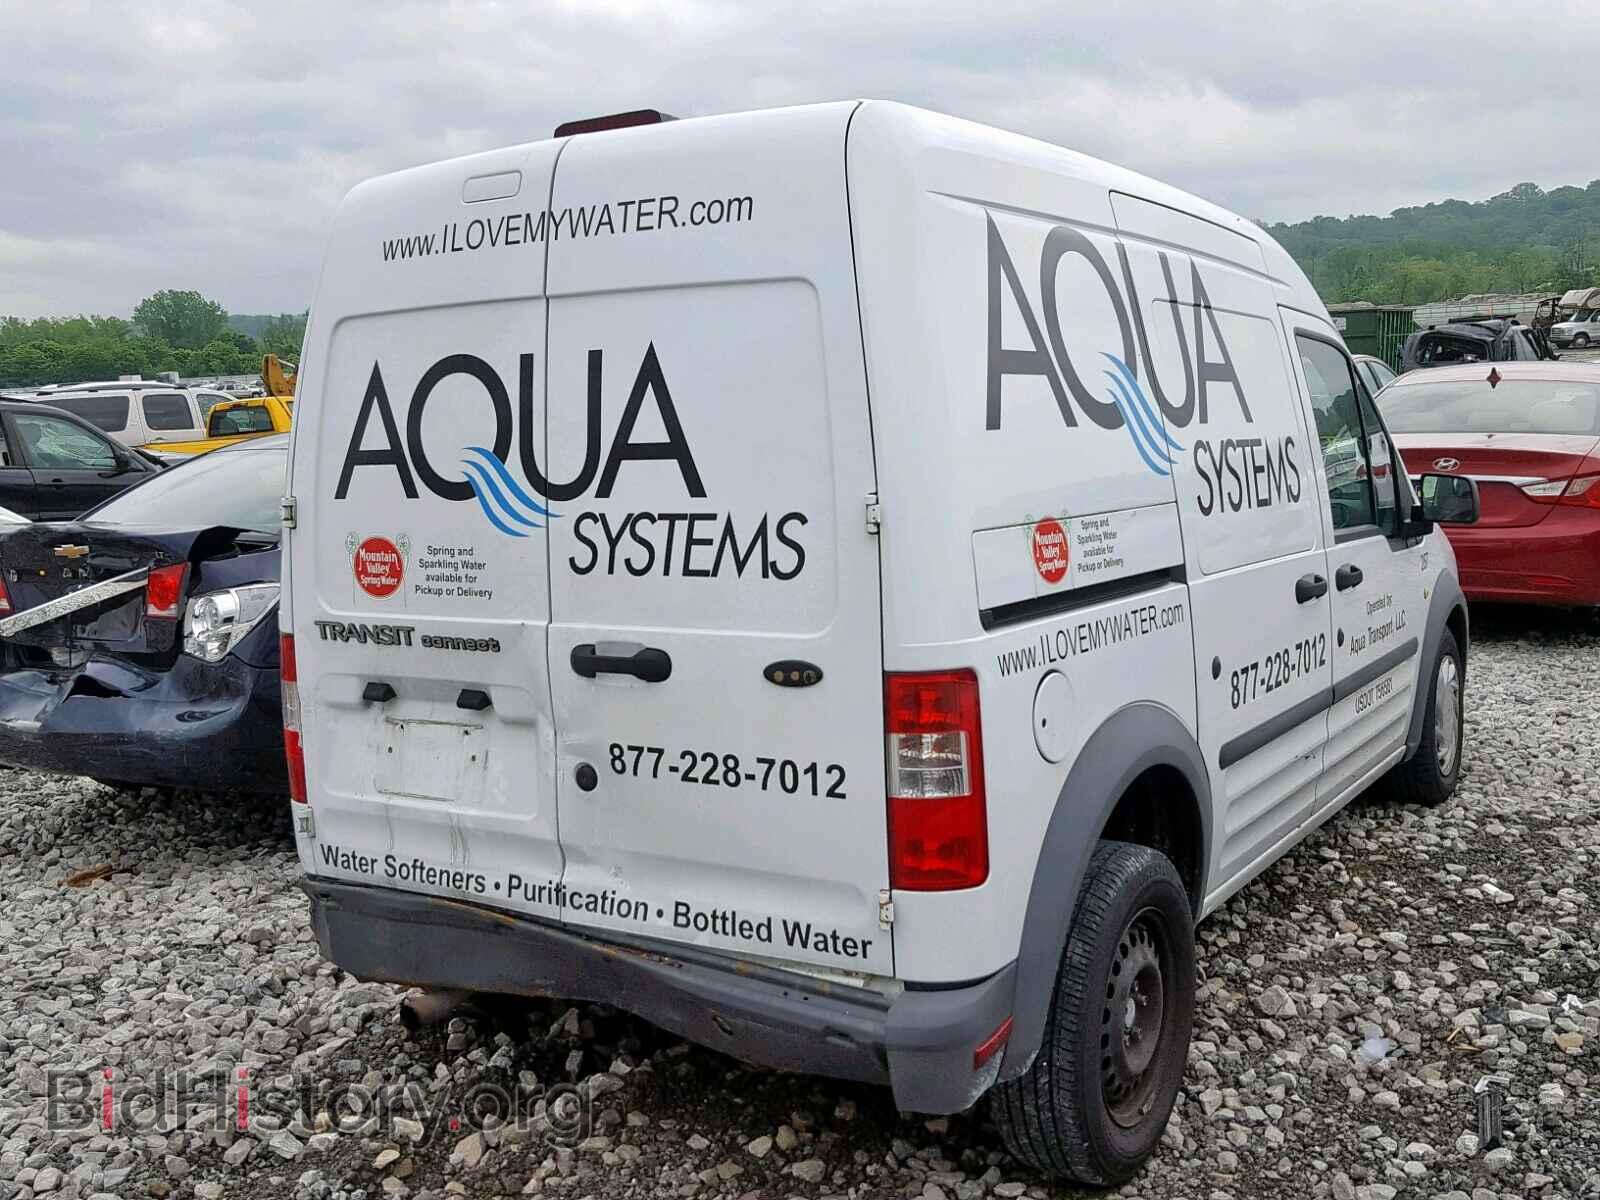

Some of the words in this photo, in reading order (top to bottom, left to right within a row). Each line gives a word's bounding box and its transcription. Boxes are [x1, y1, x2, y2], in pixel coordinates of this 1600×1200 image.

[382, 196, 754, 261] www.ILOVEMYWATER.com
[984, 207, 1254, 430] AQUA
[334, 340, 707, 502] AQUA
[1194, 436, 1300, 516] SYSTEMS
[1081, 519, 1099, 530] Spring
[1100, 517, 1109, 528] and
[569, 511, 808, 580] SYSTEMS
[1077, 532, 1103, 545] Sparkling
[1103, 530, 1118, 540] Water
[359, 548, 400, 571] Mountain
[427, 545, 455, 557] Spring
[457, 546, 474, 557] and
[1041, 543, 1060, 559] Valley
[1083, 545, 1106, 558] available
[1106, 544, 1114, 555] for
[366, 562, 391, 575] Valley
[418, 558, 459, 571] Sparkling
[460, 560, 487, 571] Water
[1077, 561, 1096, 573] Pickup
[1097, 561, 1103, 570] or
[1103, 557, 1124, 569] Delivery
[361, 575, 380, 587] Spring
[380, 575, 399, 585] Water
[425, 573, 463, 583] available
[464, 574, 478, 584] for
[415, 585, 444, 597] Pickup
[445, 588, 455, 596] or
[457, 586, 493, 600] Delivery
[314, 620, 415, 646] TRANSIT
[421, 635, 501, 652] connect
[997, 600, 1185, 678] www.ILOVEMYWATER.com
[1350, 635, 1366, 657] Aqua
[1230, 631, 1327, 710] 877-228-7012
[608, 741, 848, 800] 877-228-7012
[319, 843, 378, 875] Water
[383, 853, 487, 894] Softeners
[508, 873, 649, 922] Purification
[674, 900, 773, 943] Bottled
[781, 919, 873, 959] Water
